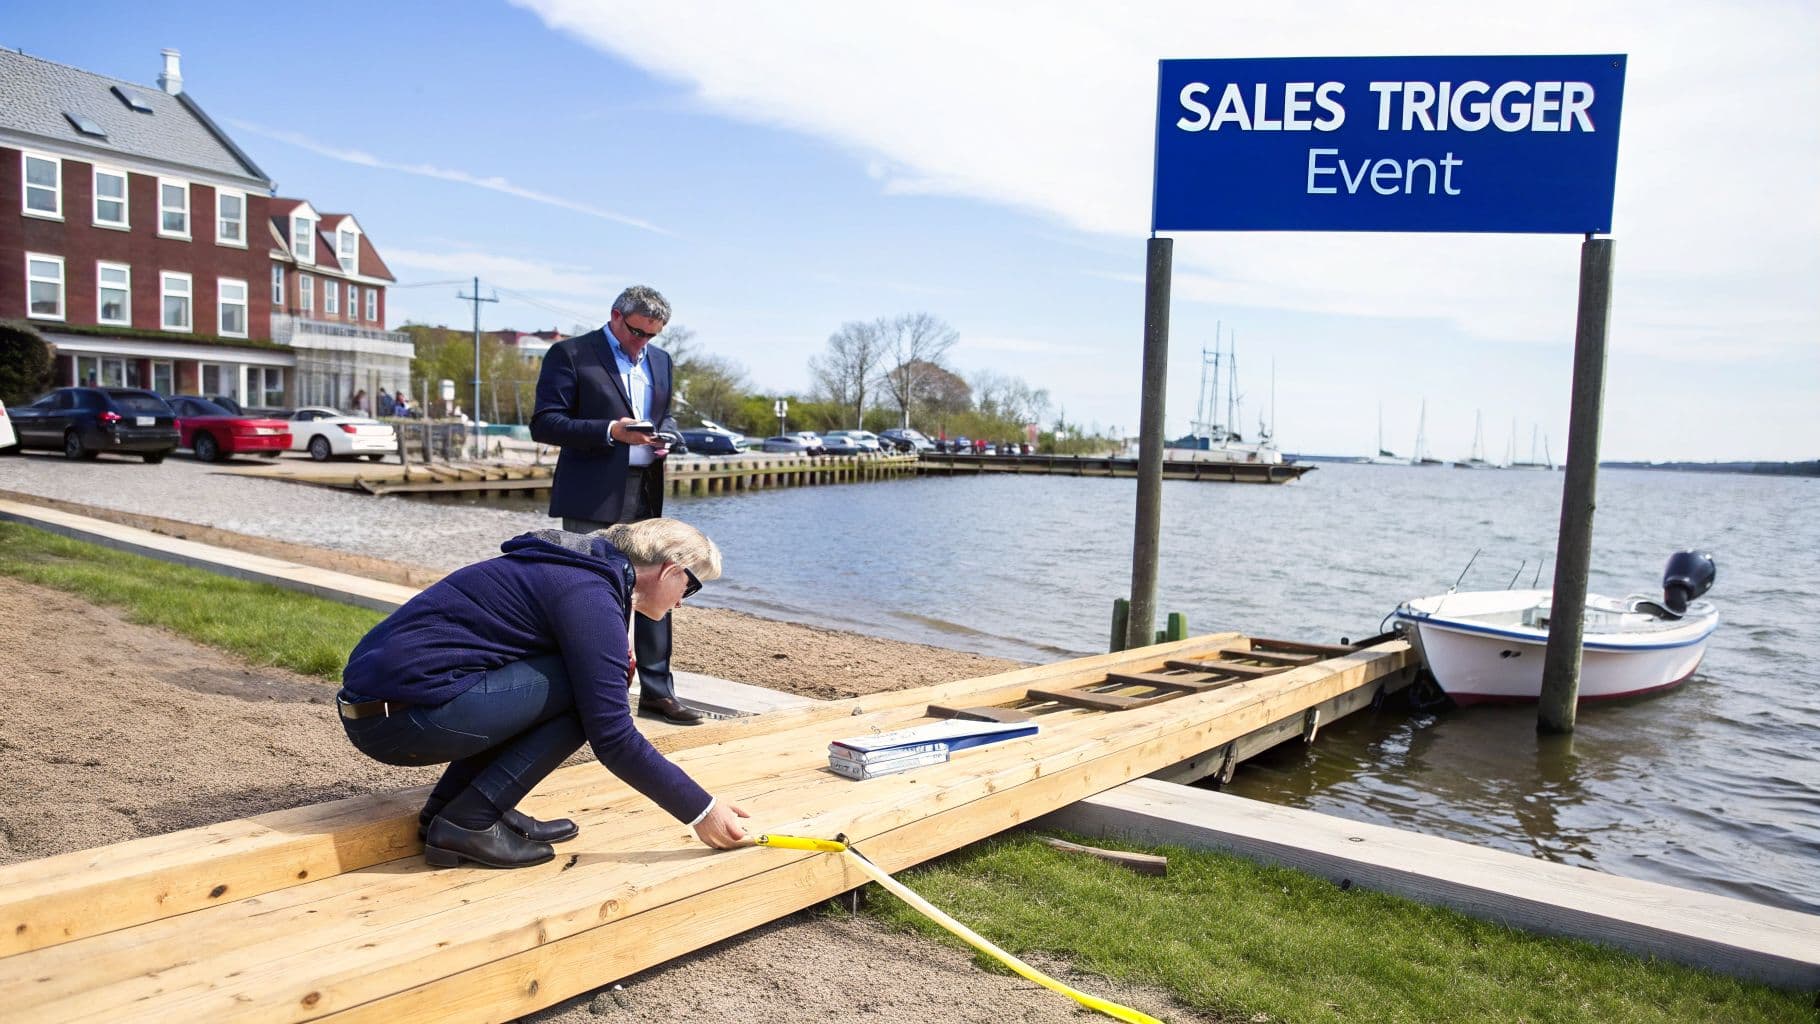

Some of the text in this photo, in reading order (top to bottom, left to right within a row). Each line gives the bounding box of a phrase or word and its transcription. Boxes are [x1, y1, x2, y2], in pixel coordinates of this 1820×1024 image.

[1177, 81, 1596, 132] SALES TRIGGER
[1306, 148, 1463, 196] Event
